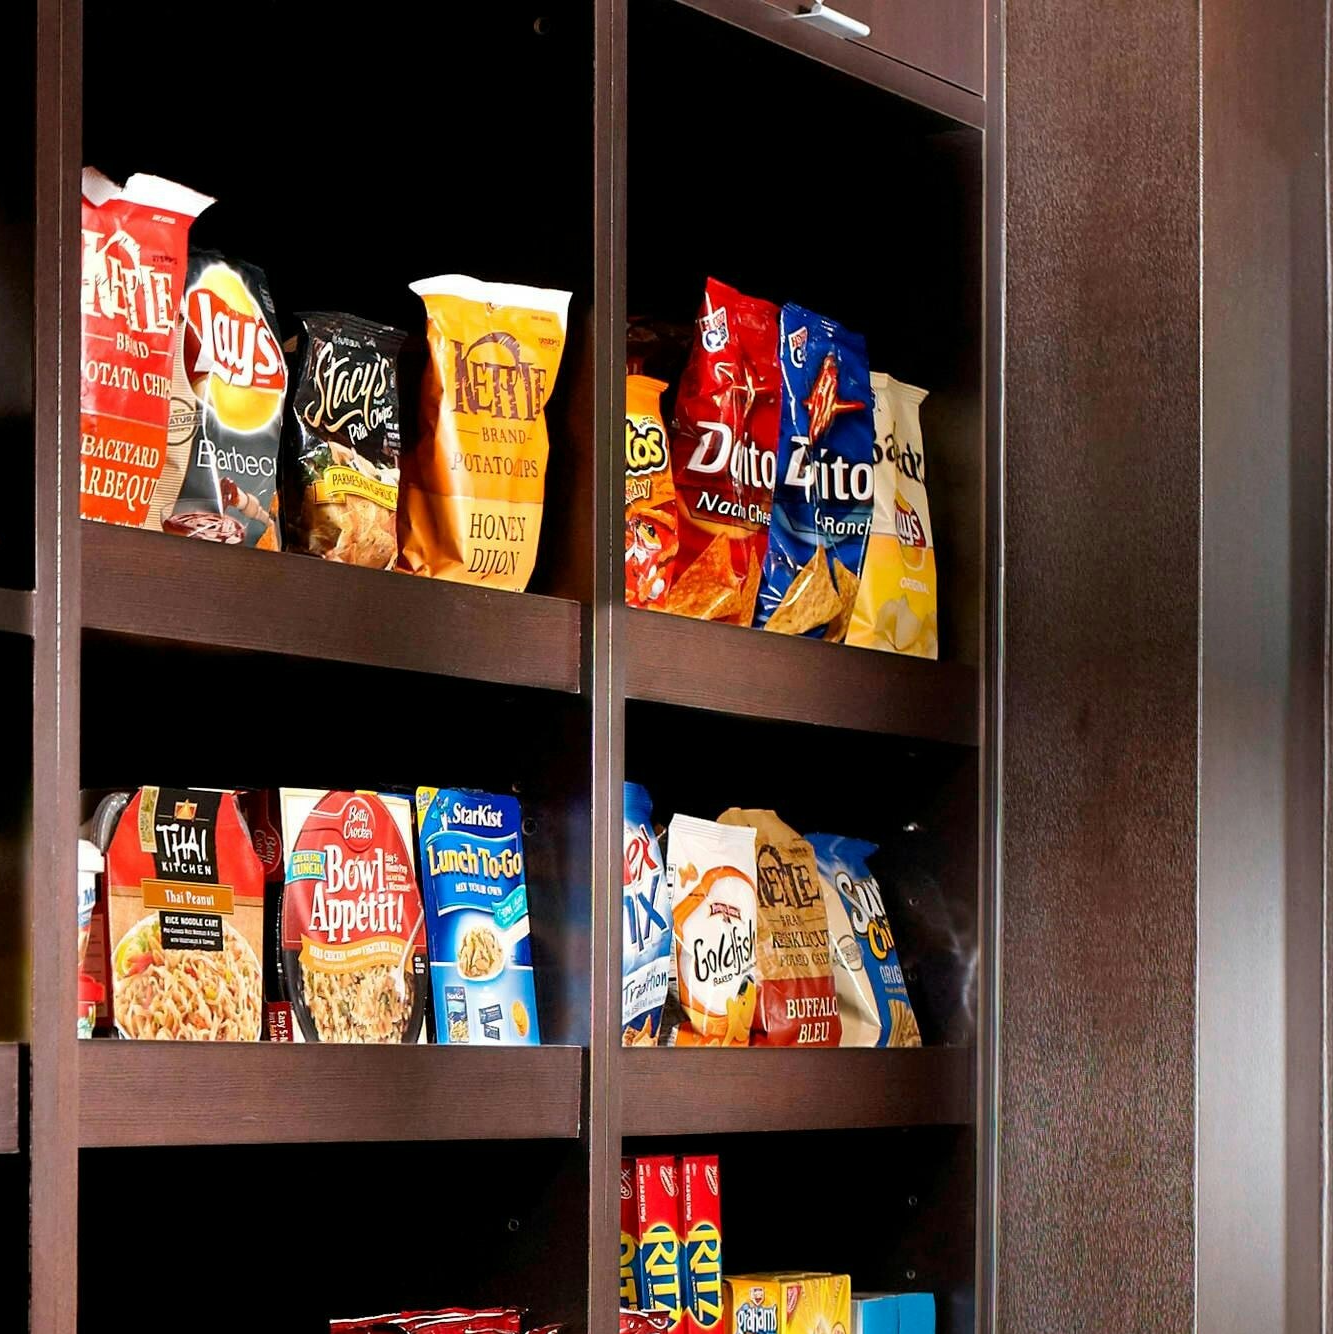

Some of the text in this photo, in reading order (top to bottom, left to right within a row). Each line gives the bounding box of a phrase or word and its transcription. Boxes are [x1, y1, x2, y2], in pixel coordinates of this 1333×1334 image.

[304, 342, 390, 432] Stacy's
[482, 427, 525, 444] BRAND
[81, 433, 159, 469] BACKYARD
[451, 452, 513, 476] POTATO
[469, 513, 526, 542] HONEY
[468, 548, 520, 580] DIJON
[349, 805, 369, 825] Betty
[453, 802, 503, 828] StarKist
[343, 820, 373, 839] Crocker
[156, 823, 208, 866] THAI
[161, 861, 212, 875] KITCHEN
[324, 846, 386, 894] Bowl
[427, 843, 479, 876] Lunch
[165, 889, 215, 906] Thai Peanut
[309, 881, 404, 943] Appétit!
[786, 996, 838, 1020] BUFFALO
[797, 1021, 830, 1044] BLEU
[687, 1230, 724, 1322] RITZ
